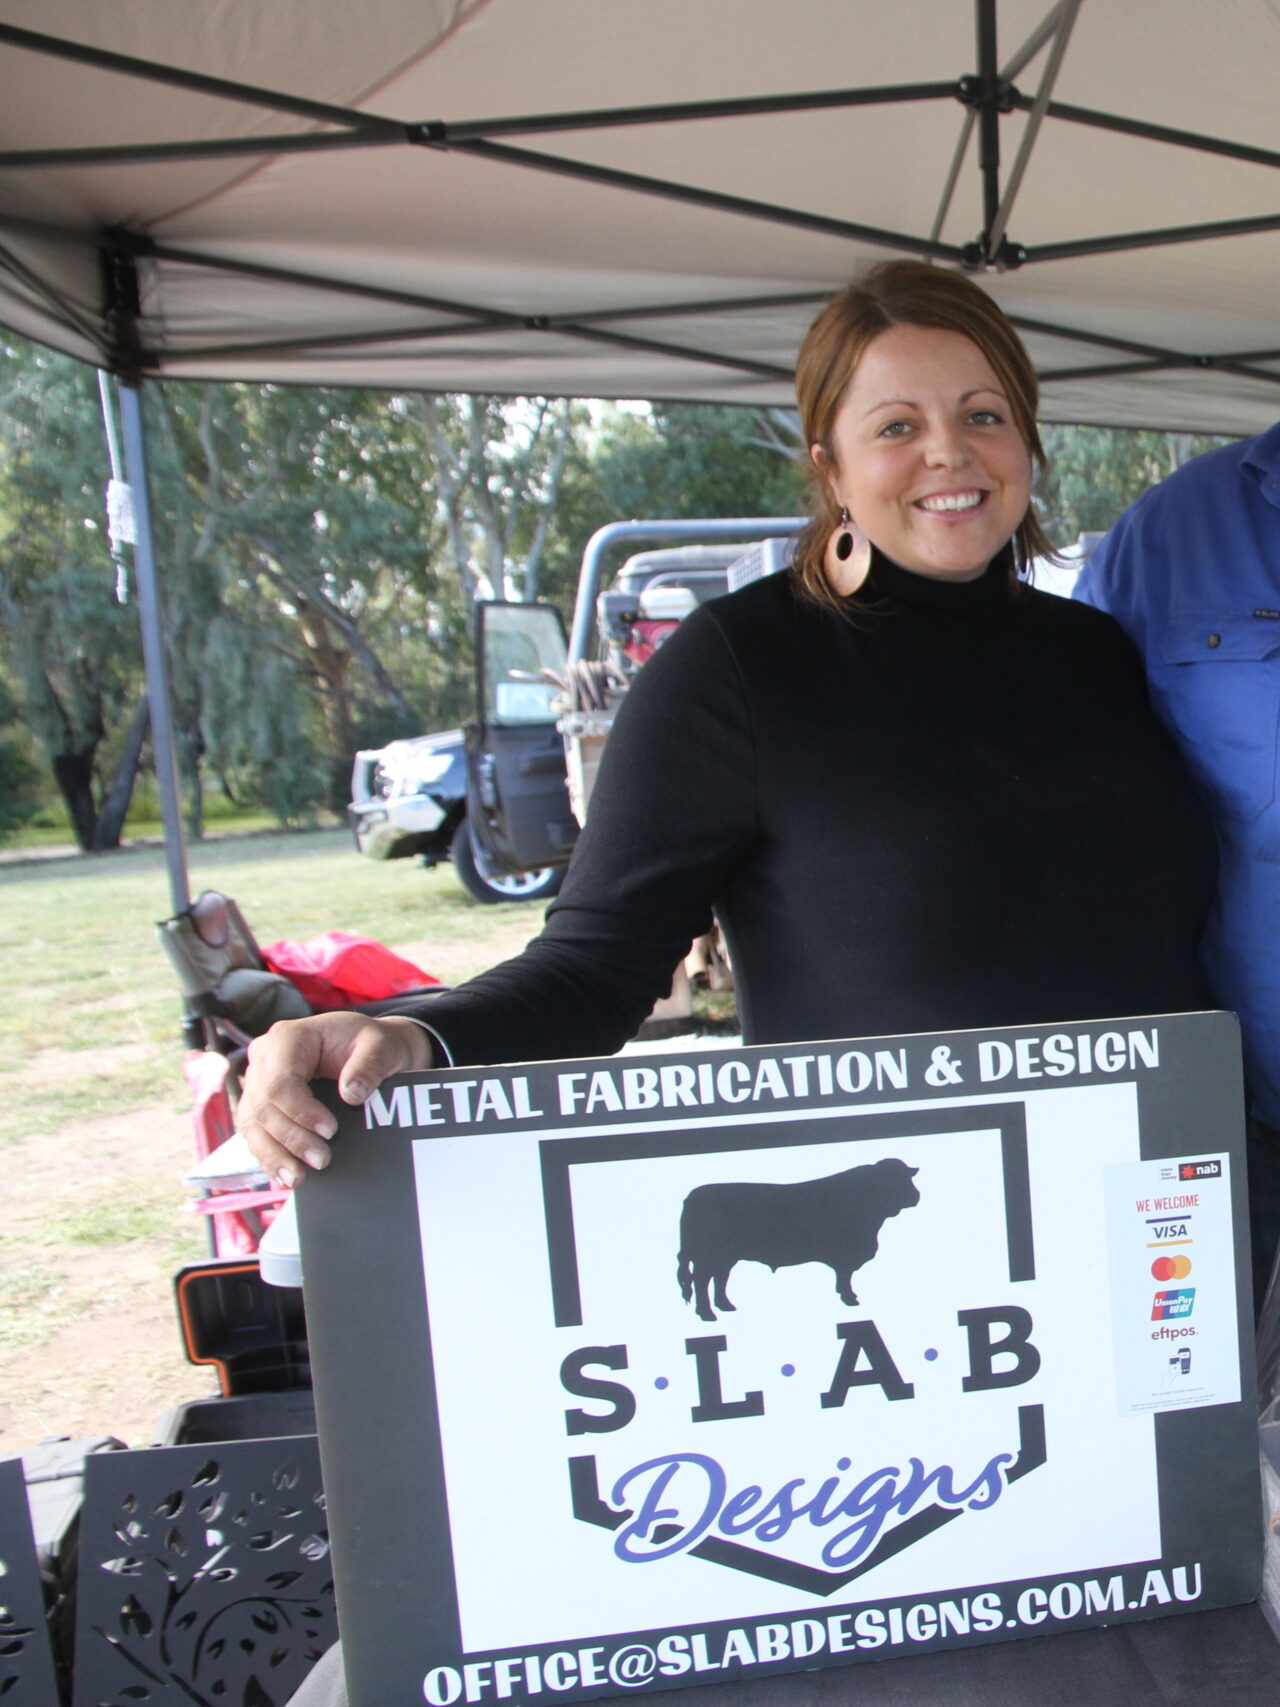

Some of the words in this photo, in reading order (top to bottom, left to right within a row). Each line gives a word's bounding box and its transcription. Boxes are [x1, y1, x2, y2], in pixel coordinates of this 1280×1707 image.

[364, 1076, 544, 1130] METAL
[557, 1048, 909, 1116] FABRICATION
[924, 1045, 964, 1087] &
[978, 1028, 1160, 1083] DESIGN
[1196, 1163, 1219, 1175] nab
[1136, 1199, 1151, 1212] WE
[1154, 1194, 1200, 1211] WELCOME
[1153, 1223, 1188, 1239] VISA
[1155, 1295, 1194, 1307] UnionPay
[1151, 1326, 1196, 1341] eftpos
[611, 1453, 1014, 1568] Designs
[422, 1563, 1202, 1706] OFFICE@SLABDESIGNS.COM.AU
